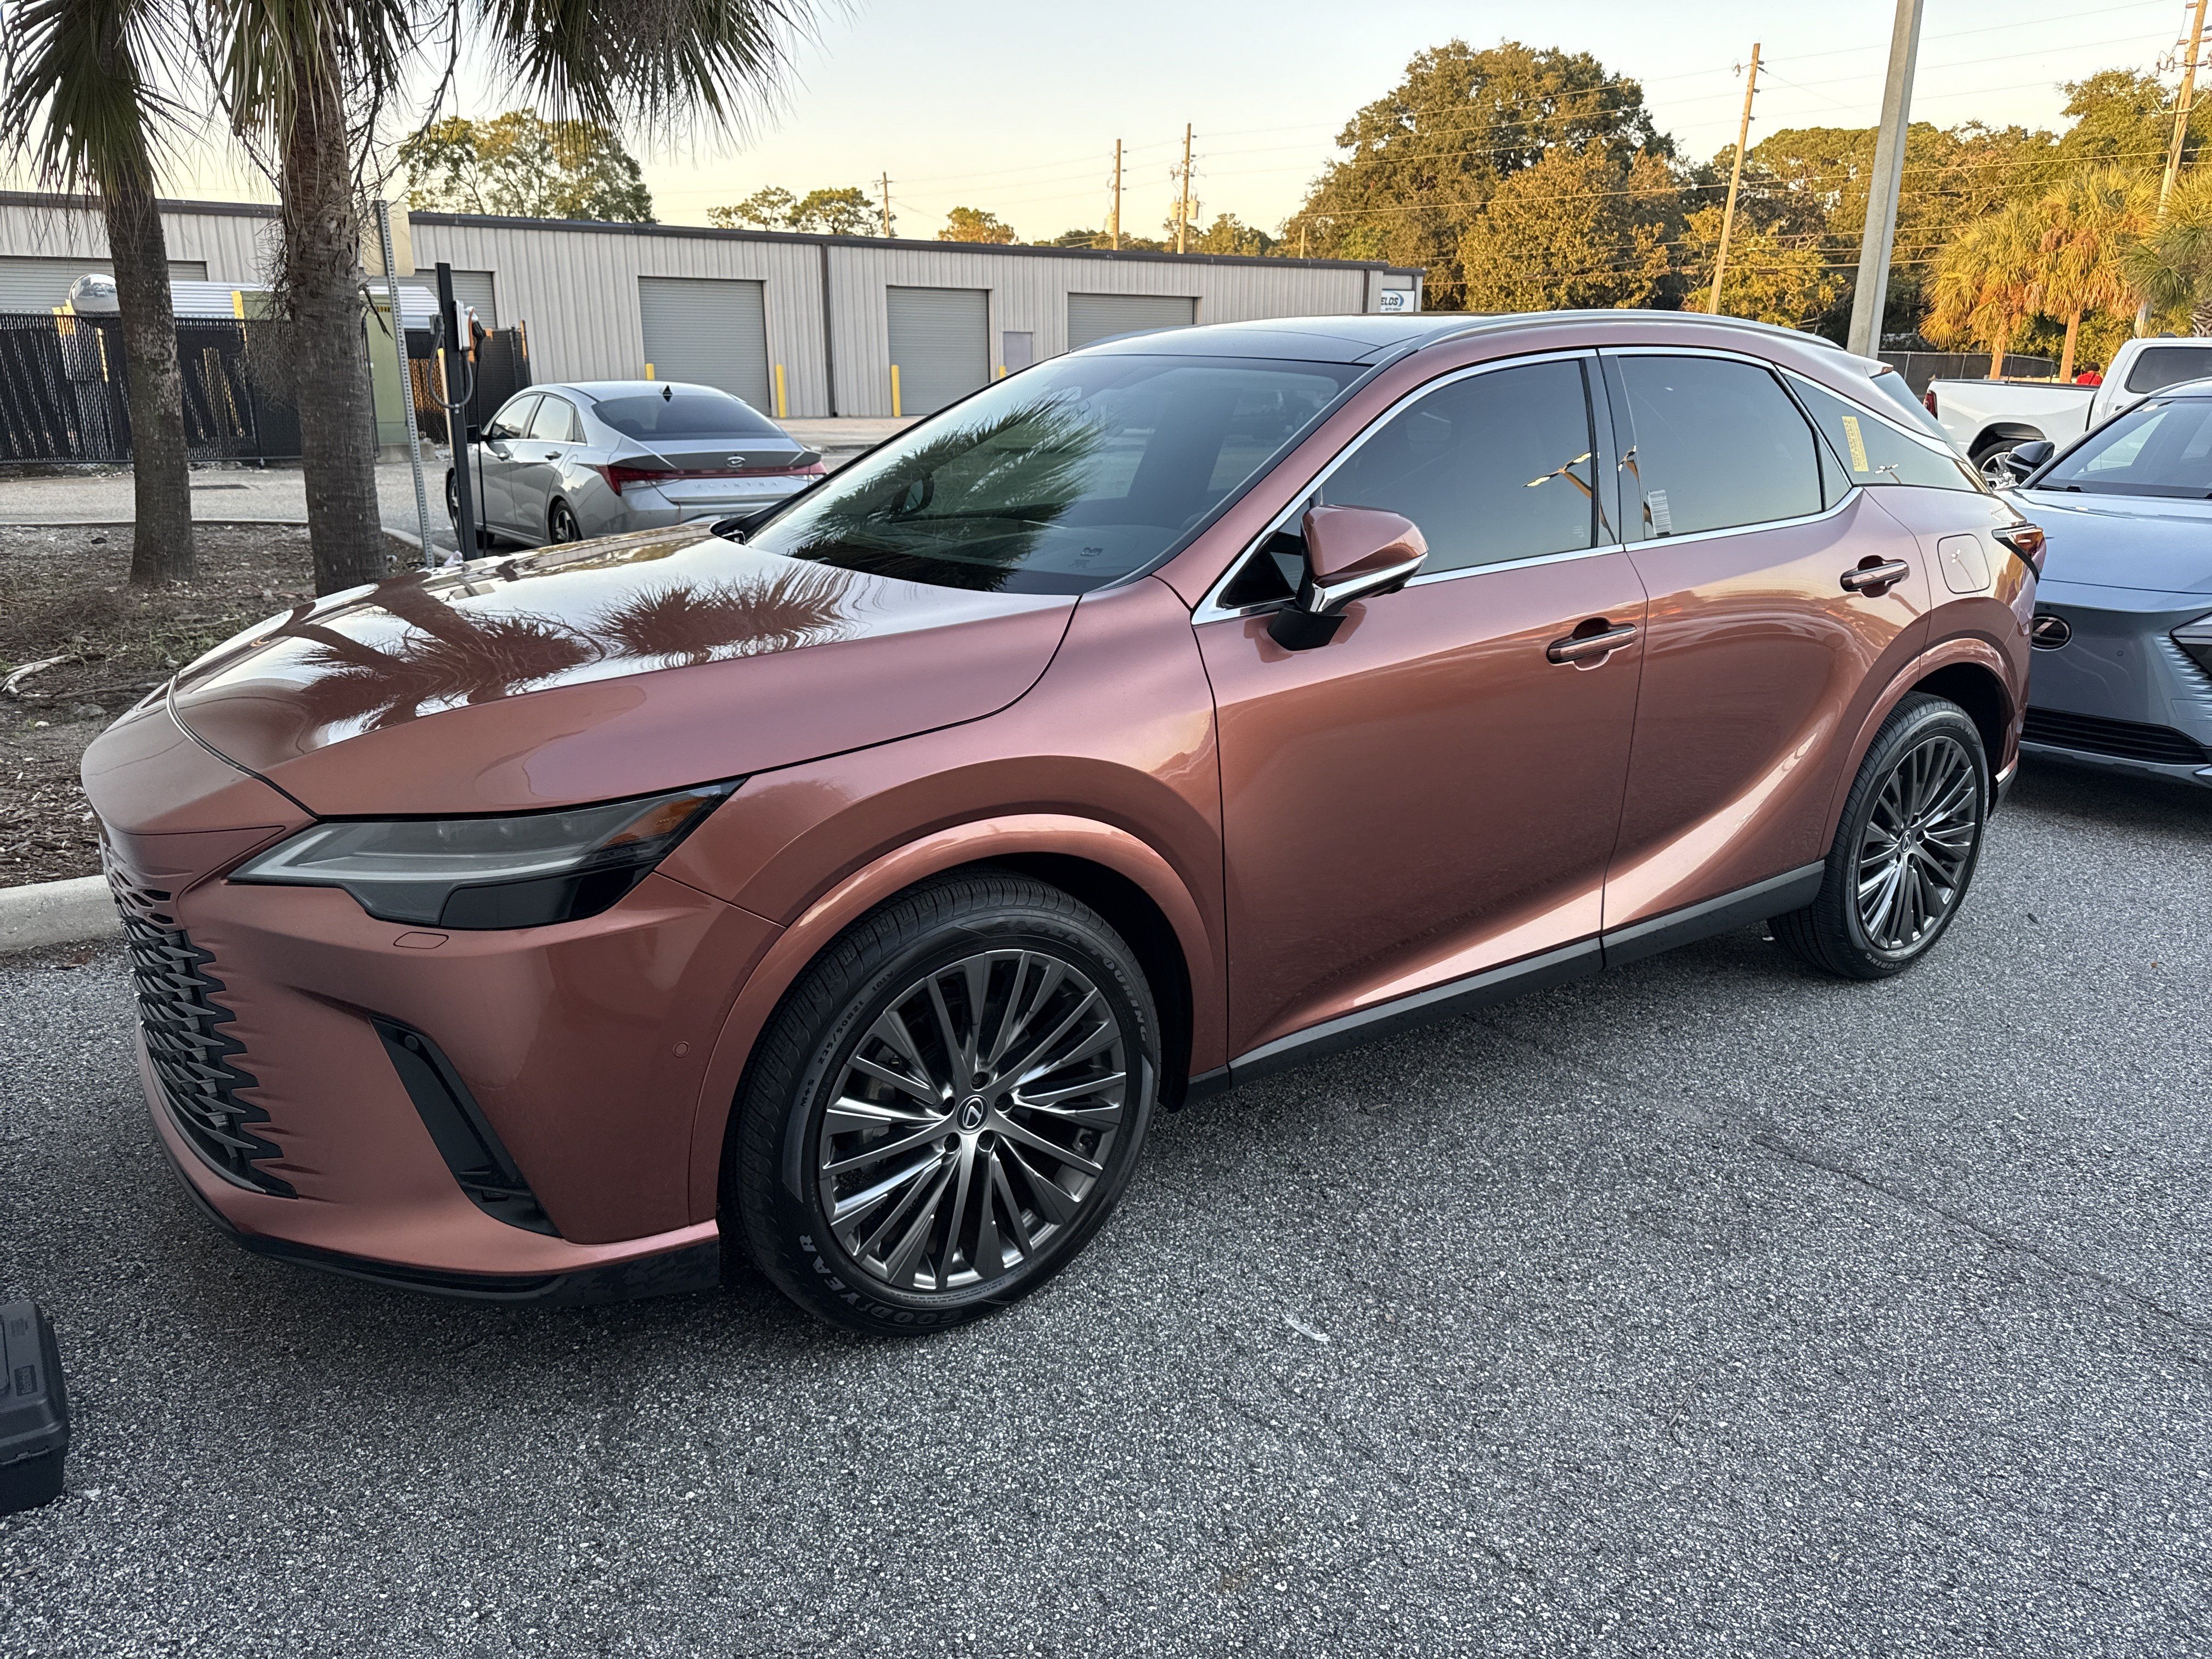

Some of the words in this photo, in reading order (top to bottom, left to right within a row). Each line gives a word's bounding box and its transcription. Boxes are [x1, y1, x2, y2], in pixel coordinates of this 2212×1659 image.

[991, 921, 1084, 945] EAGLE
[1090, 944, 1149, 1042] TOURING
[799, 1234, 963, 1325] GOODYEAR
